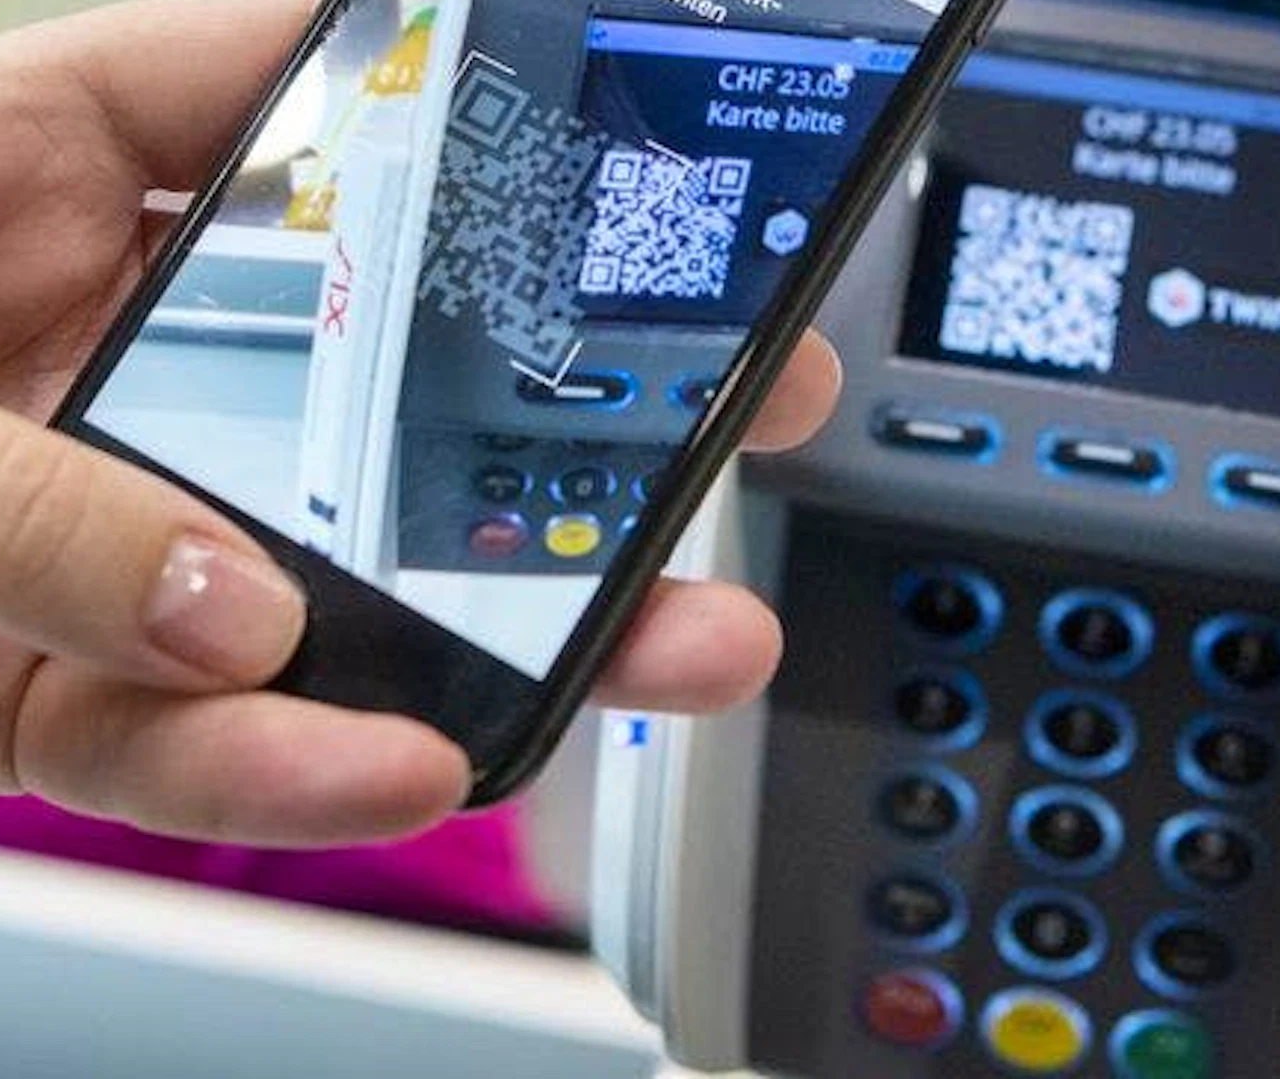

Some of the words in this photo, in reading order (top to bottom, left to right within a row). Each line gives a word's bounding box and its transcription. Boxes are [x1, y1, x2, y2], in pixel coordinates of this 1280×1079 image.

[718, 64, 774, 94] CHF
[777, 69, 849, 99] 23.05
[706, 99, 780, 130] Karte
[784, 105, 846, 135] bitte
[1073, 141, 1160, 185] Karte
